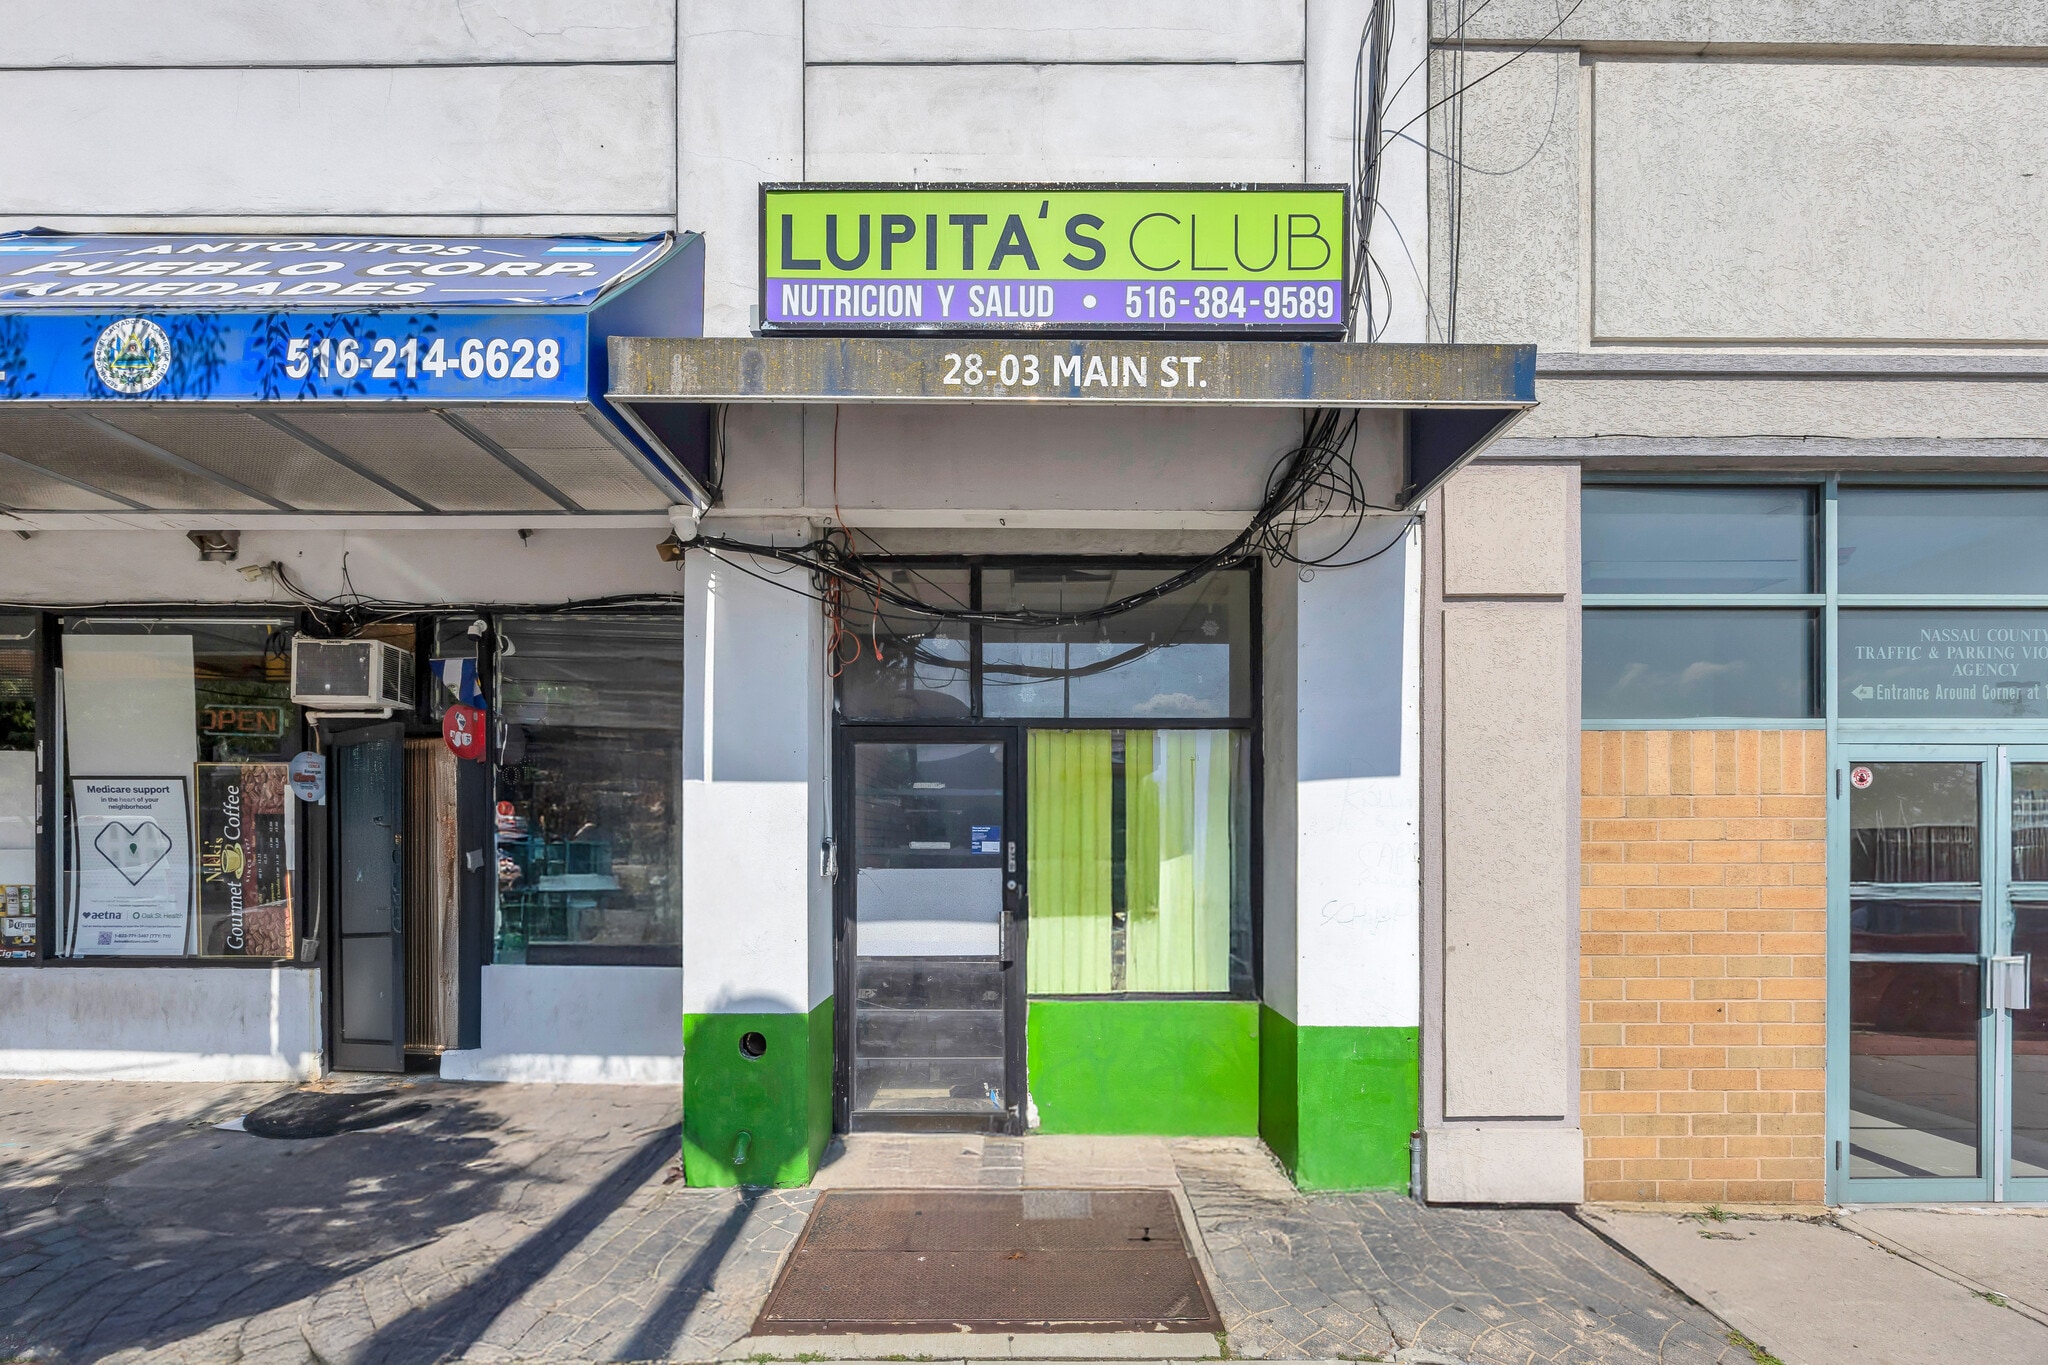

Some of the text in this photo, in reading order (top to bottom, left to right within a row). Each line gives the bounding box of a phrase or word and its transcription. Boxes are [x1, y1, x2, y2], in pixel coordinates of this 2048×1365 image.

[781, 200, 1332, 273] LUPITA'S CLUB
[124, 241, 483, 256] ANTOJITOS
[9, 261, 598, 277] PUEBLO CORP.
[782, 284, 1335, 319] NUTRICION Y SALUD 516-384-9589
[285, 338, 560, 379] 516-214-6628
[942, 352, 1208, 388] 28-03 MAIN ST.
[1920, 628, 2048, 642] NASSAU COUNTY
[1855, 646, 1922, 660] TRAFFIC
[1929, 646, 1939, 659] &
[1947, 646, 2015, 660] PARKING
[1952, 663, 2020, 677] AGENCY
[1876, 684, 1929, 700] Entrance
[1935, 684, 1977, 700] Around
[1982, 684, 2022, 700] Corner
[2027, 684, 2039, 700] at
[197, 709, 277, 731] OPEN
[86, 785, 170, 795] Medicare support
[203, 837, 224, 882] Nikki's
[223, 785, 244, 950] Gourmet Coffee
[91, 911, 122, 920] aetna
